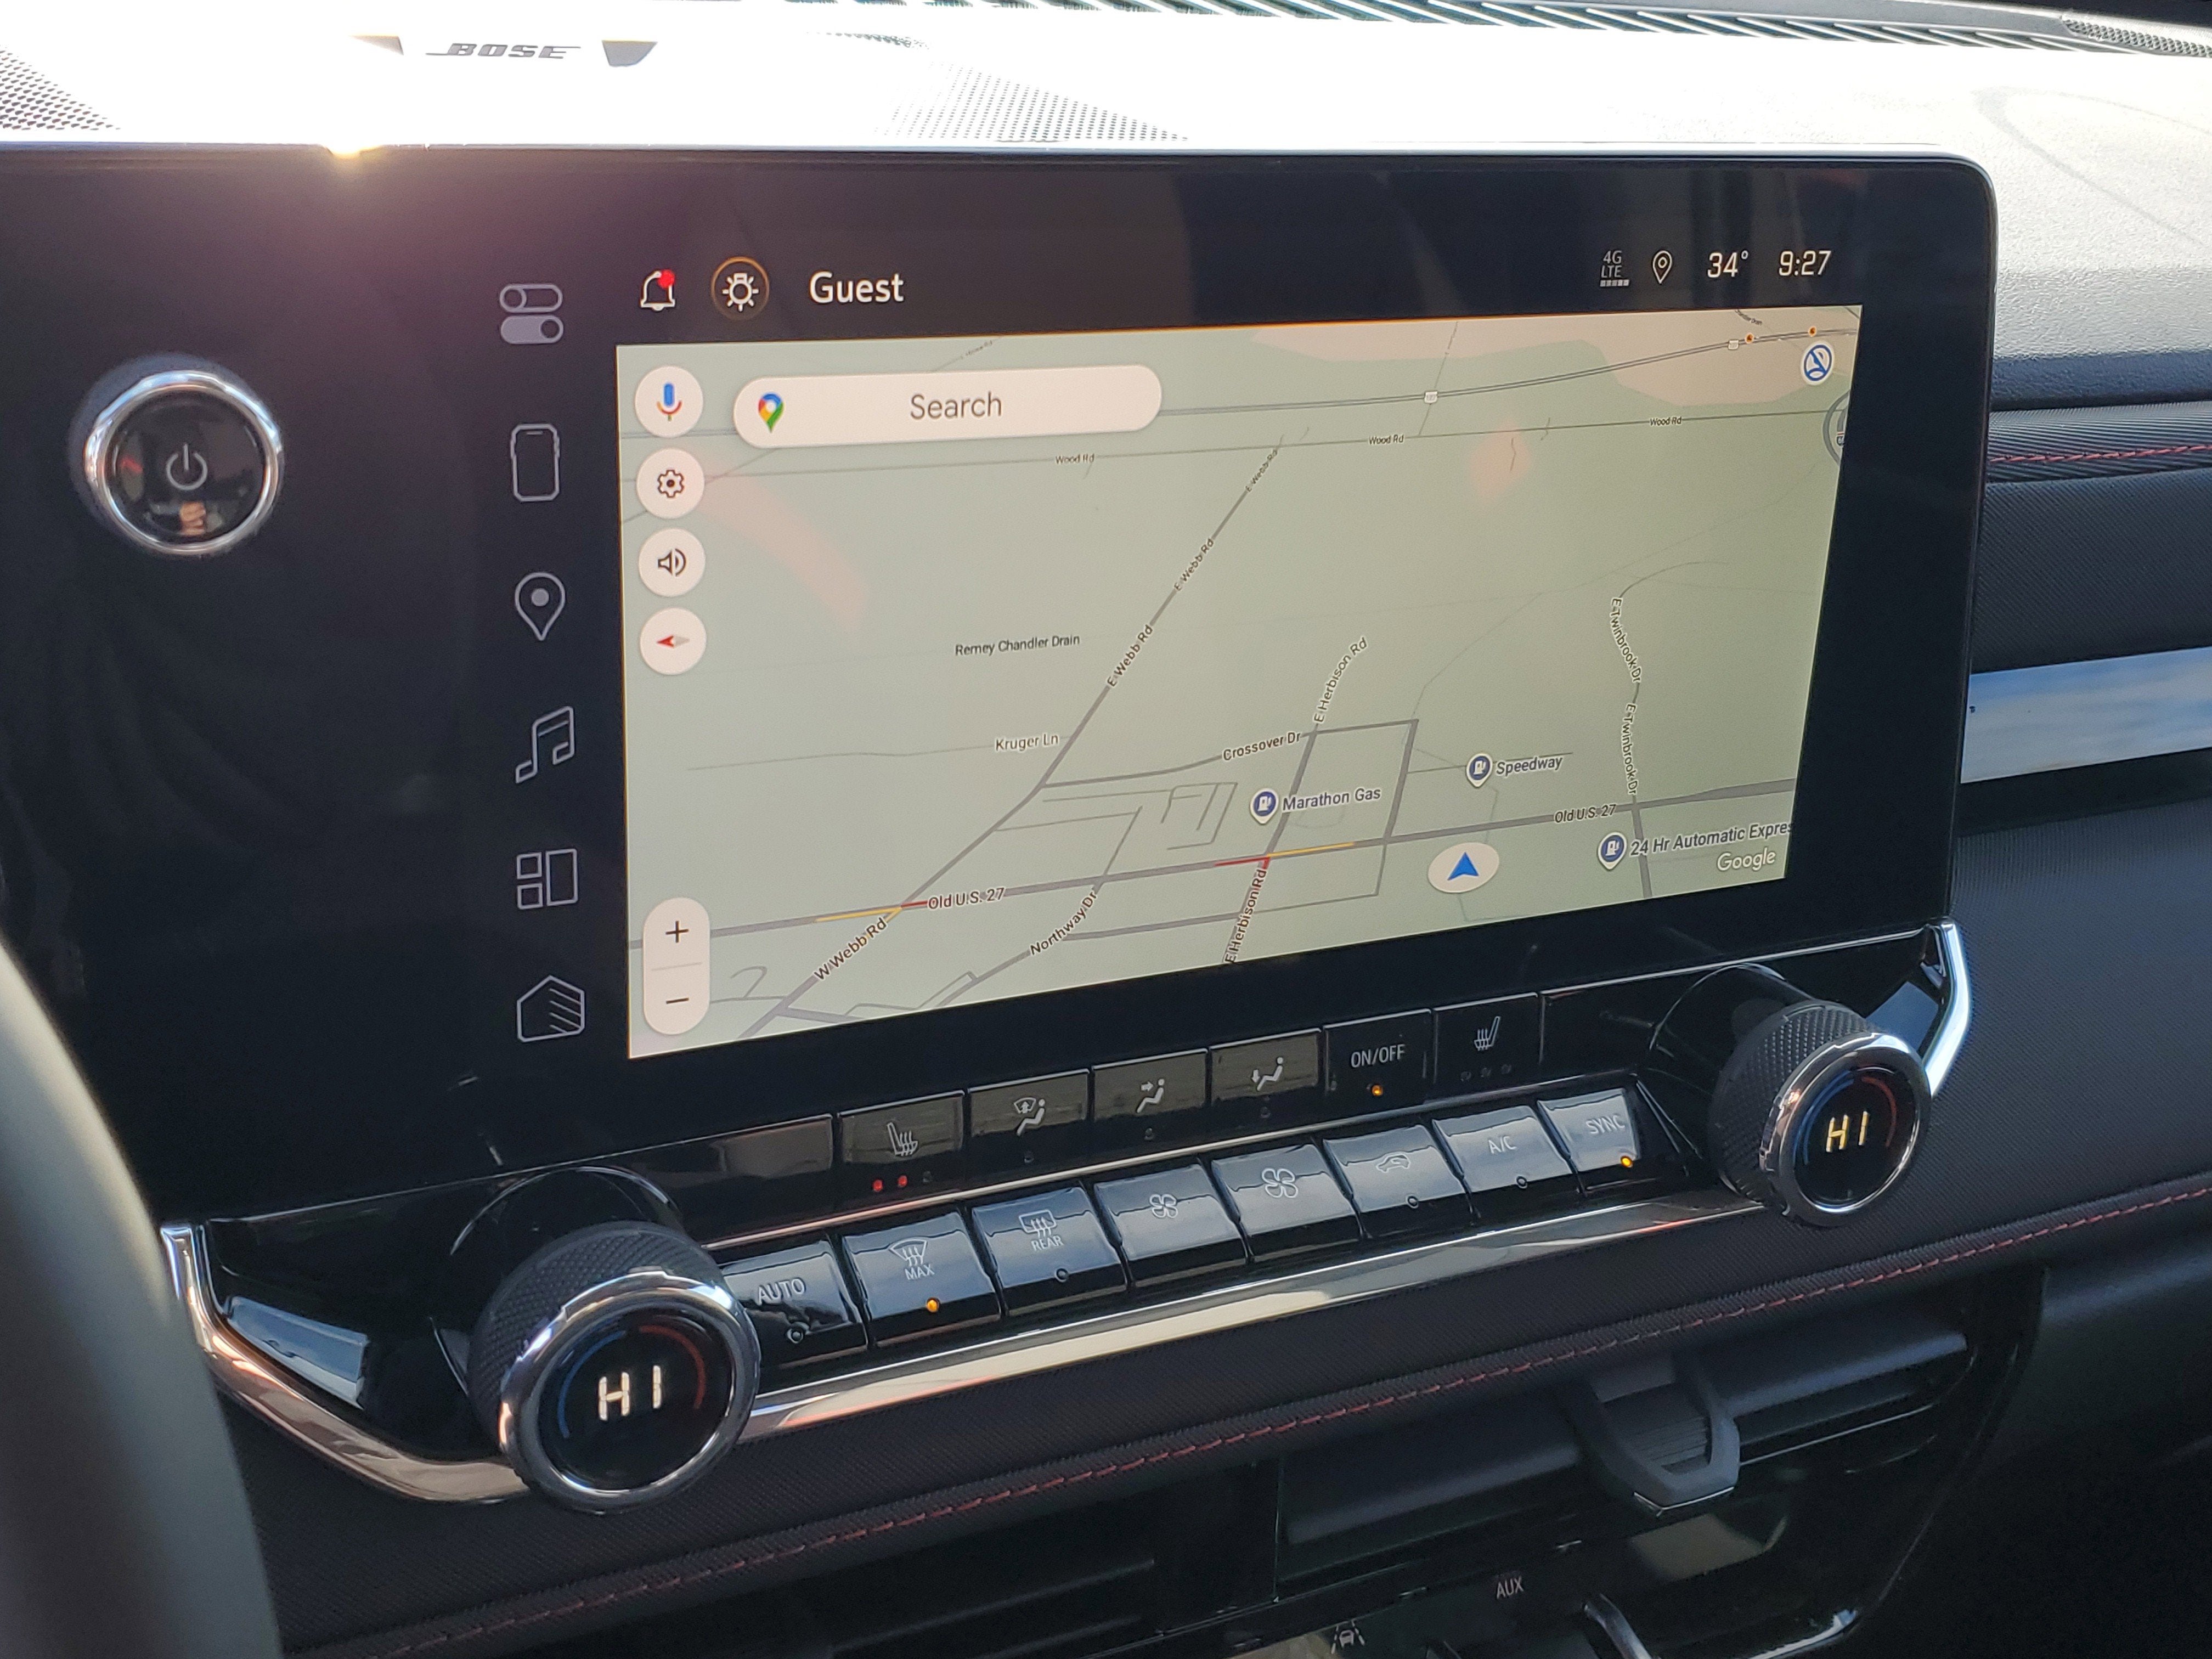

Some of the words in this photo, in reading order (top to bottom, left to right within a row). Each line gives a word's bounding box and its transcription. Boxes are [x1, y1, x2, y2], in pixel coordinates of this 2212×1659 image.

[426, 43, 581, 59] BOSE
[1603, 250, 1622, 265] 4G
[1779, 250, 1832, 277] 9:27
[1601, 264, 1622, 279] LTE
[809, 271, 905, 304] Guest
[909, 391, 1002, 420] Search
[1650, 417, 1671, 426] Wood
[1672, 416, 1682, 425] Rd
[1369, 435, 1391, 445] Wood
[1056, 454, 1080, 464] Wood
[1250, 461, 1269, 484] Webb
[1266, 449, 1278, 461] Rd
[1174, 582, 1183, 591] E
[1180, 554, 1203, 582] Webb
[1200, 538, 1214, 554] Rd
[1613, 599, 1622, 607] E
[998, 637, 1048, 652] Chandler
[1052, 634, 1080, 647] Drain
[1350, 636, 1367, 656] Rd
[1611, 608, 1637, 669] Twinbrook
[1107, 676, 1117, 687] E
[1113, 643, 1141, 676] Webb
[1137, 624, 1153, 643] Rd
[1318, 654, 1352, 710] Herbison
[1631, 667, 1641, 682] Dr
[1313, 713, 1325, 723] E
[1626, 704, 1637, 713] E
[996, 737, 1039, 751] Kruger
[1043, 733, 1058, 746] Ln
[1223, 736, 1284, 761] Crossover
[1287, 732, 1301, 744] Dr
[1622, 715, 1637, 780] Twinbrook
[1496, 756, 1562, 777] Speedway
[1628, 780, 1638, 794] Dr
[1283, 792, 1350, 811] Marathon
[1355, 788, 1381, 801] Gas
[1555, 809, 1573, 823] Old
[1577, 807, 1598, 820] U.S.
[1601, 804, 1616, 817] 27
[1630, 839, 1649, 856] 24
[1653, 837, 1670, 853] Hr
[1673, 827, 1745, 850] Automatic
[1717, 847, 1776, 871] Google
[1251, 869, 1267, 888] Rd
[928, 894, 952, 909] Old
[956, 891, 983, 905] U.S.
[987, 887, 1005, 901] 27
[1030, 908, 1086, 955] Northway
[1082, 891, 1097, 908] Dr
[1229, 890, 1260, 952] Herbison
[814, 963, 831, 980] W
[830, 934, 867, 968] Webb
[866, 917, 887, 938] Rd
[1224, 953, 1237, 963] E
[1351, 1044, 1406, 1068] ON/OFF
[1585, 1114, 1626, 1135] SYNC
[1826, 1111, 1869, 1152] HI
[1489, 1135, 1516, 1154] A/C
[1030, 1235, 1064, 1252] REAR
[904, 1263, 935, 1281] MAX
[756, 1277, 806, 1306] AUTO
[598, 1364, 663, 1421] HI
[1496, 1576, 1524, 1599] AUX
